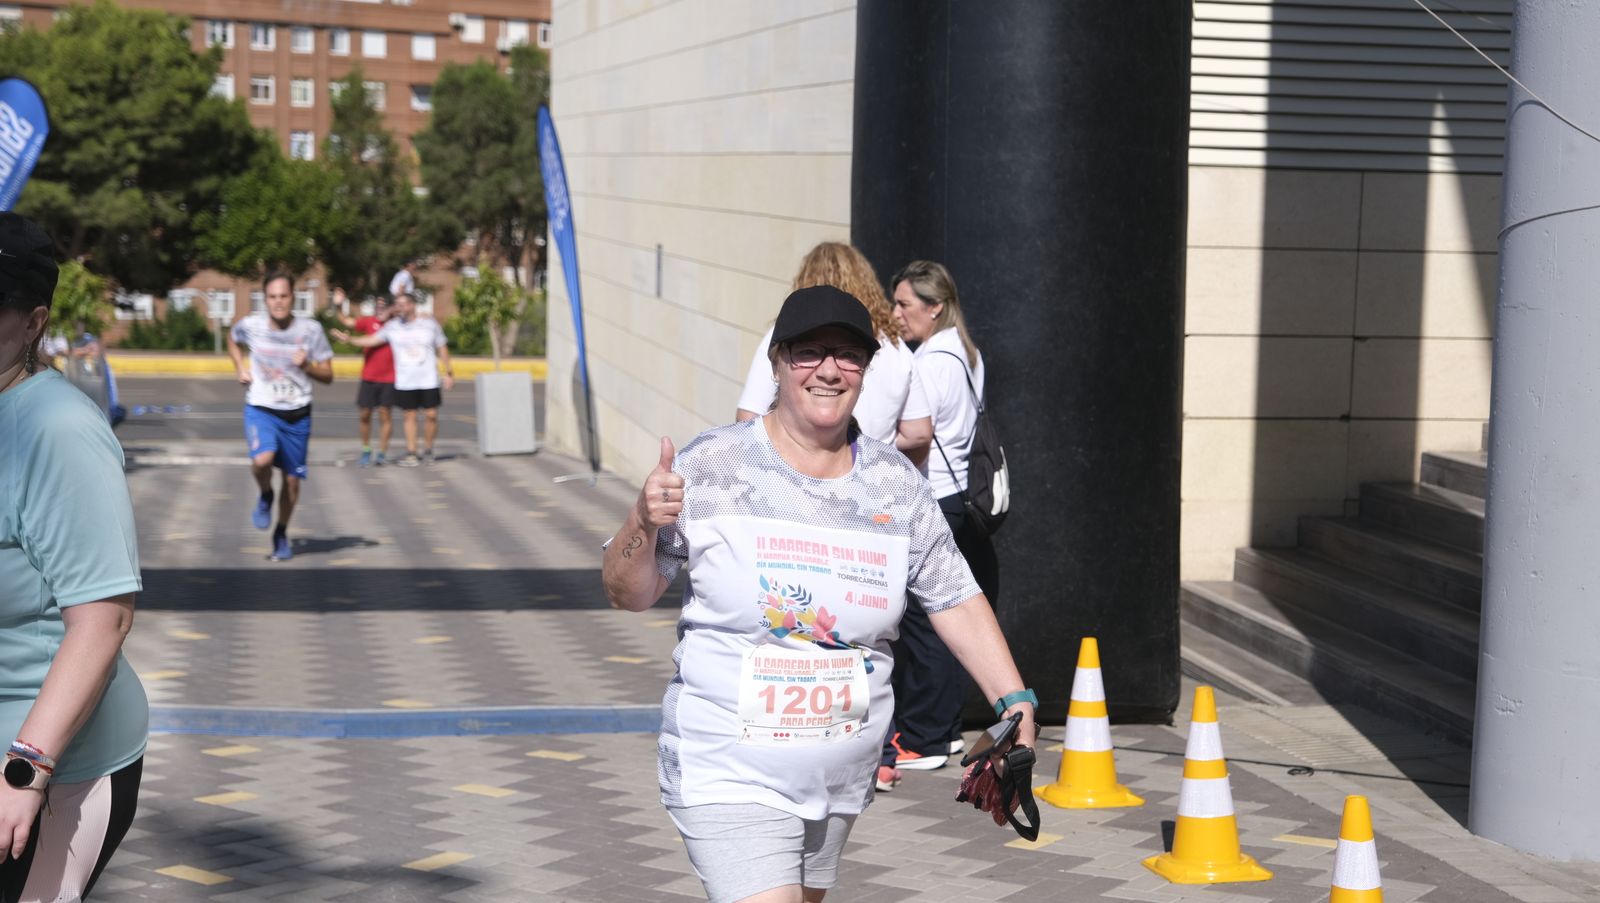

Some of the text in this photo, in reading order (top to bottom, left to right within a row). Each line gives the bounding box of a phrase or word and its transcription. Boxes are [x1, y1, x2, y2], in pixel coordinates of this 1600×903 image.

[756, 536, 888, 567] II CARRERA SIN HUMO
[791, 554, 829, 566] SALUDABLE
[768, 562, 796, 570] MUNDIAL
[809, 565, 832, 575] TABACO
[845, 591, 888, 610] 4 JUNIO
[754, 657, 854, 670] II CARRERA SIN HUMO
[763, 675, 786, 683] MUNDIAL
[758, 684, 853, 715] 1201
[780, 716, 804, 727] PACA
